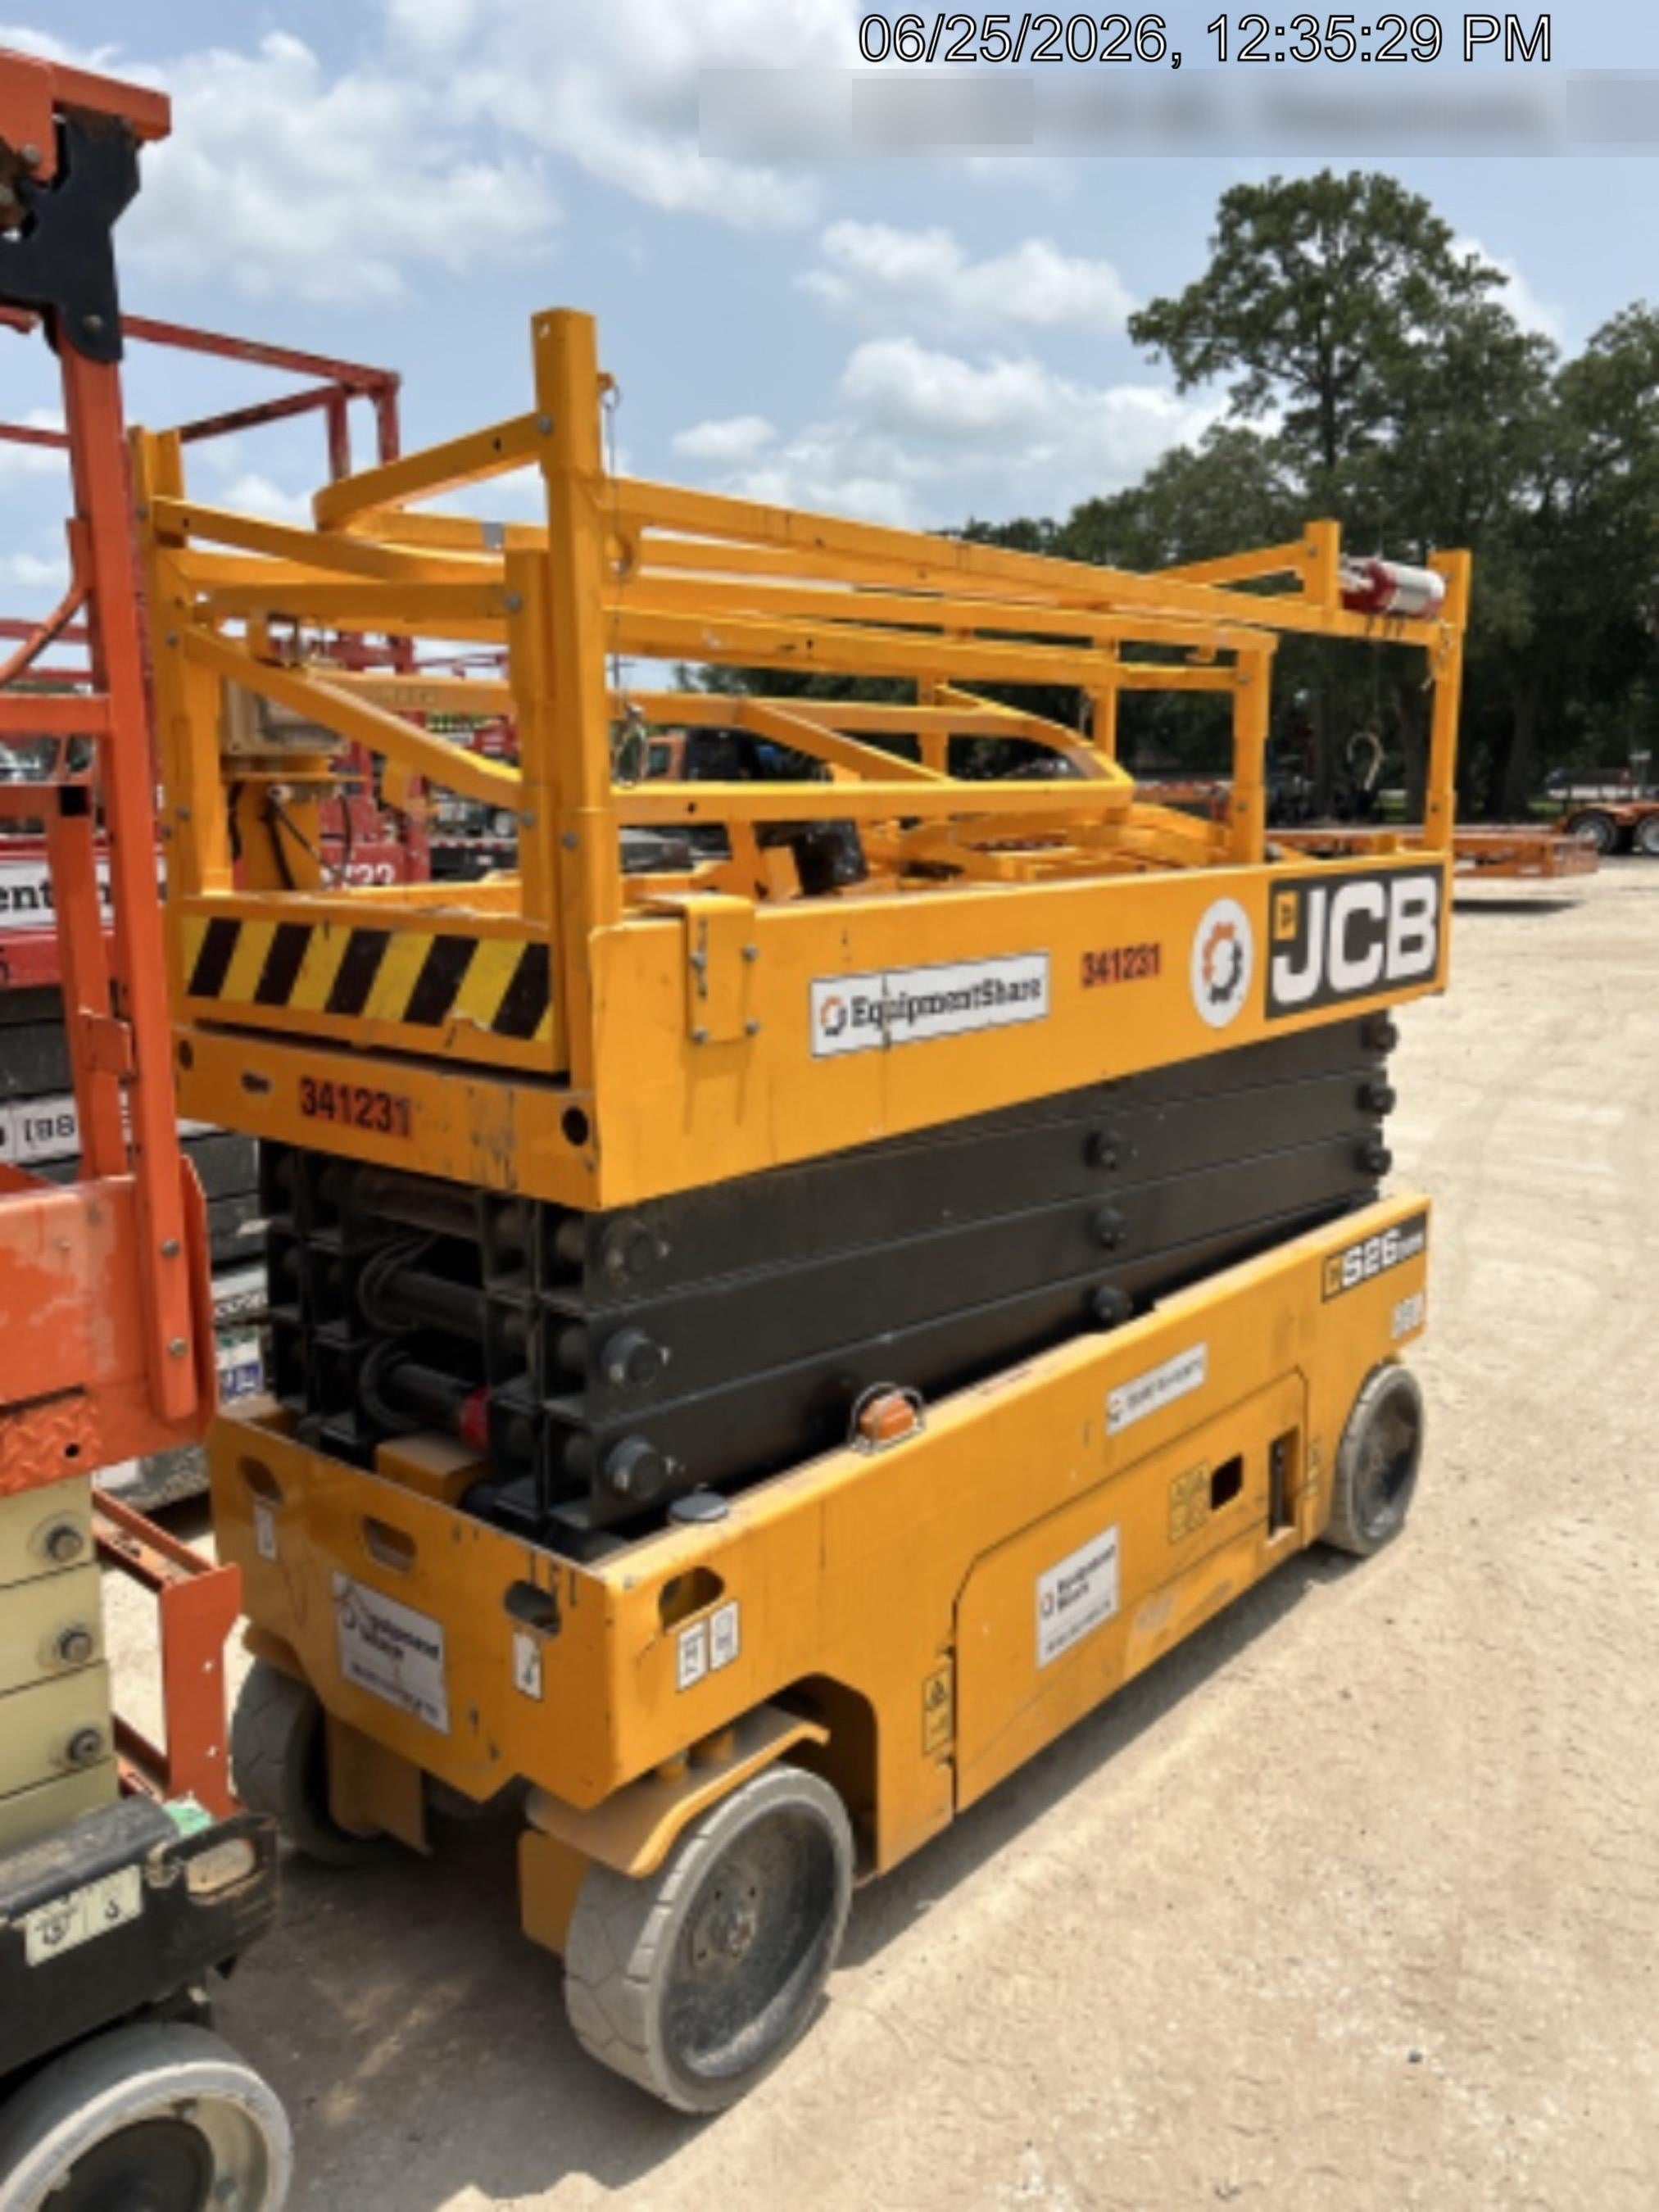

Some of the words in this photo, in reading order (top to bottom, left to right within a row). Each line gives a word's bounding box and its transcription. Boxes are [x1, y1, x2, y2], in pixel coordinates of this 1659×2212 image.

[1081, 943, 1162, 988] 341231
[1271, 876, 1439, 1006] JCB
[298, 1076, 411, 1137] 341231
